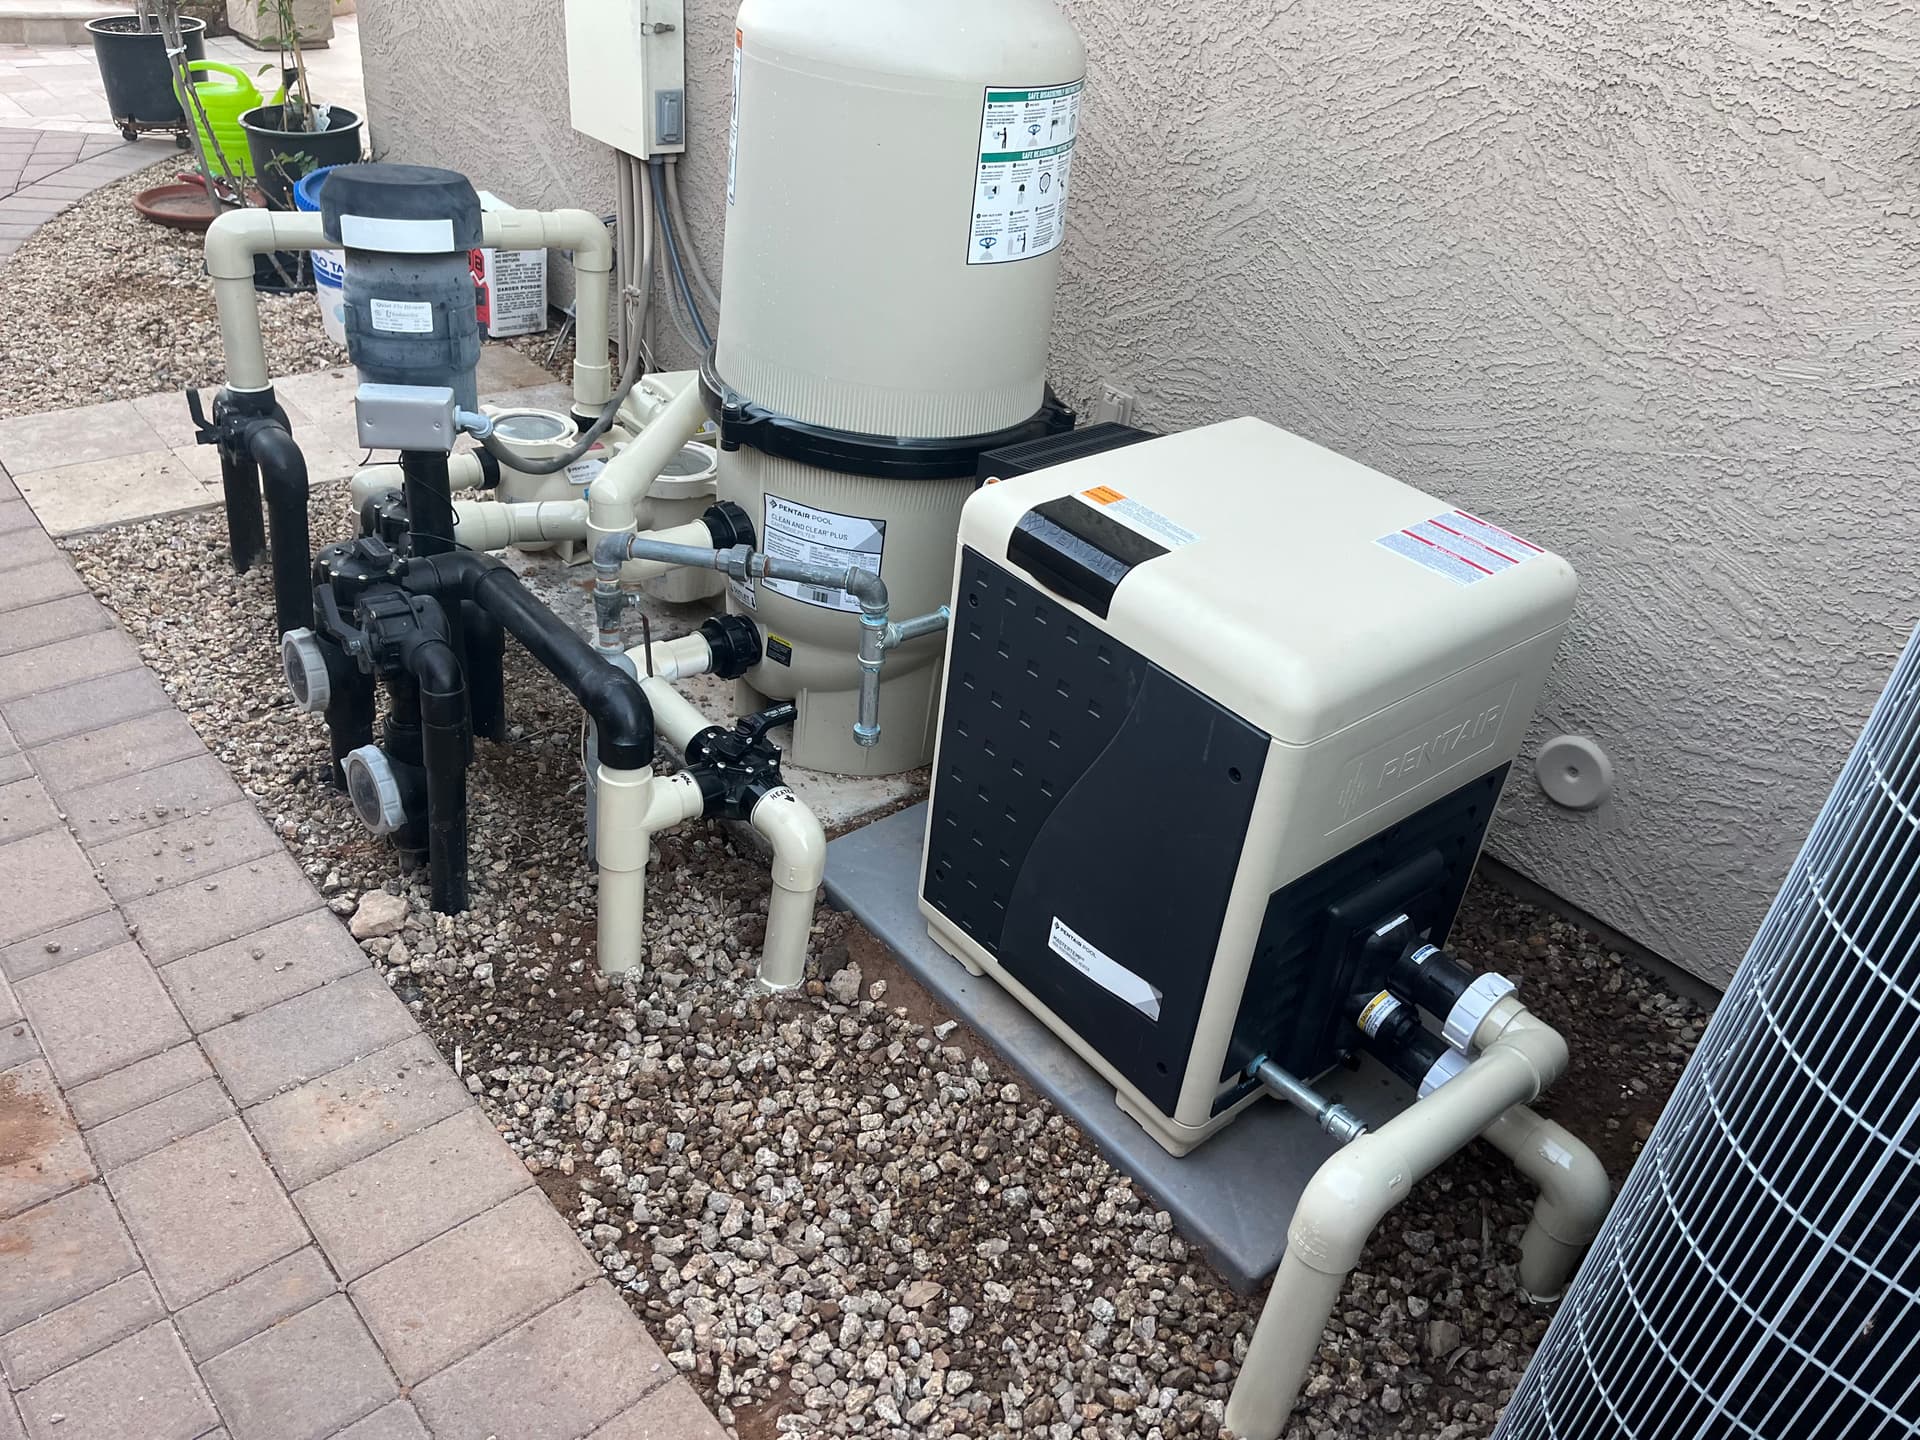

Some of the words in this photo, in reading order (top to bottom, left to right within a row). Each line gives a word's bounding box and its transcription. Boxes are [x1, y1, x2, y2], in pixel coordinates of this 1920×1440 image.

[1028, 91, 1040, 100] SAFE
[1022, 151, 1033, 160] SAFE
[779, 504, 810, 520] PENTAIR
[811, 514, 833, 526] POOL
[771, 513, 790, 526] CLEAN
[791, 520, 805, 531] AND
[830, 531, 848, 541] PLUS
[1044, 524, 1127, 578] PENTAIR
[1376, 704, 1501, 789] PENTAIR
[1060, 927, 1082, 947] PENTAIR
